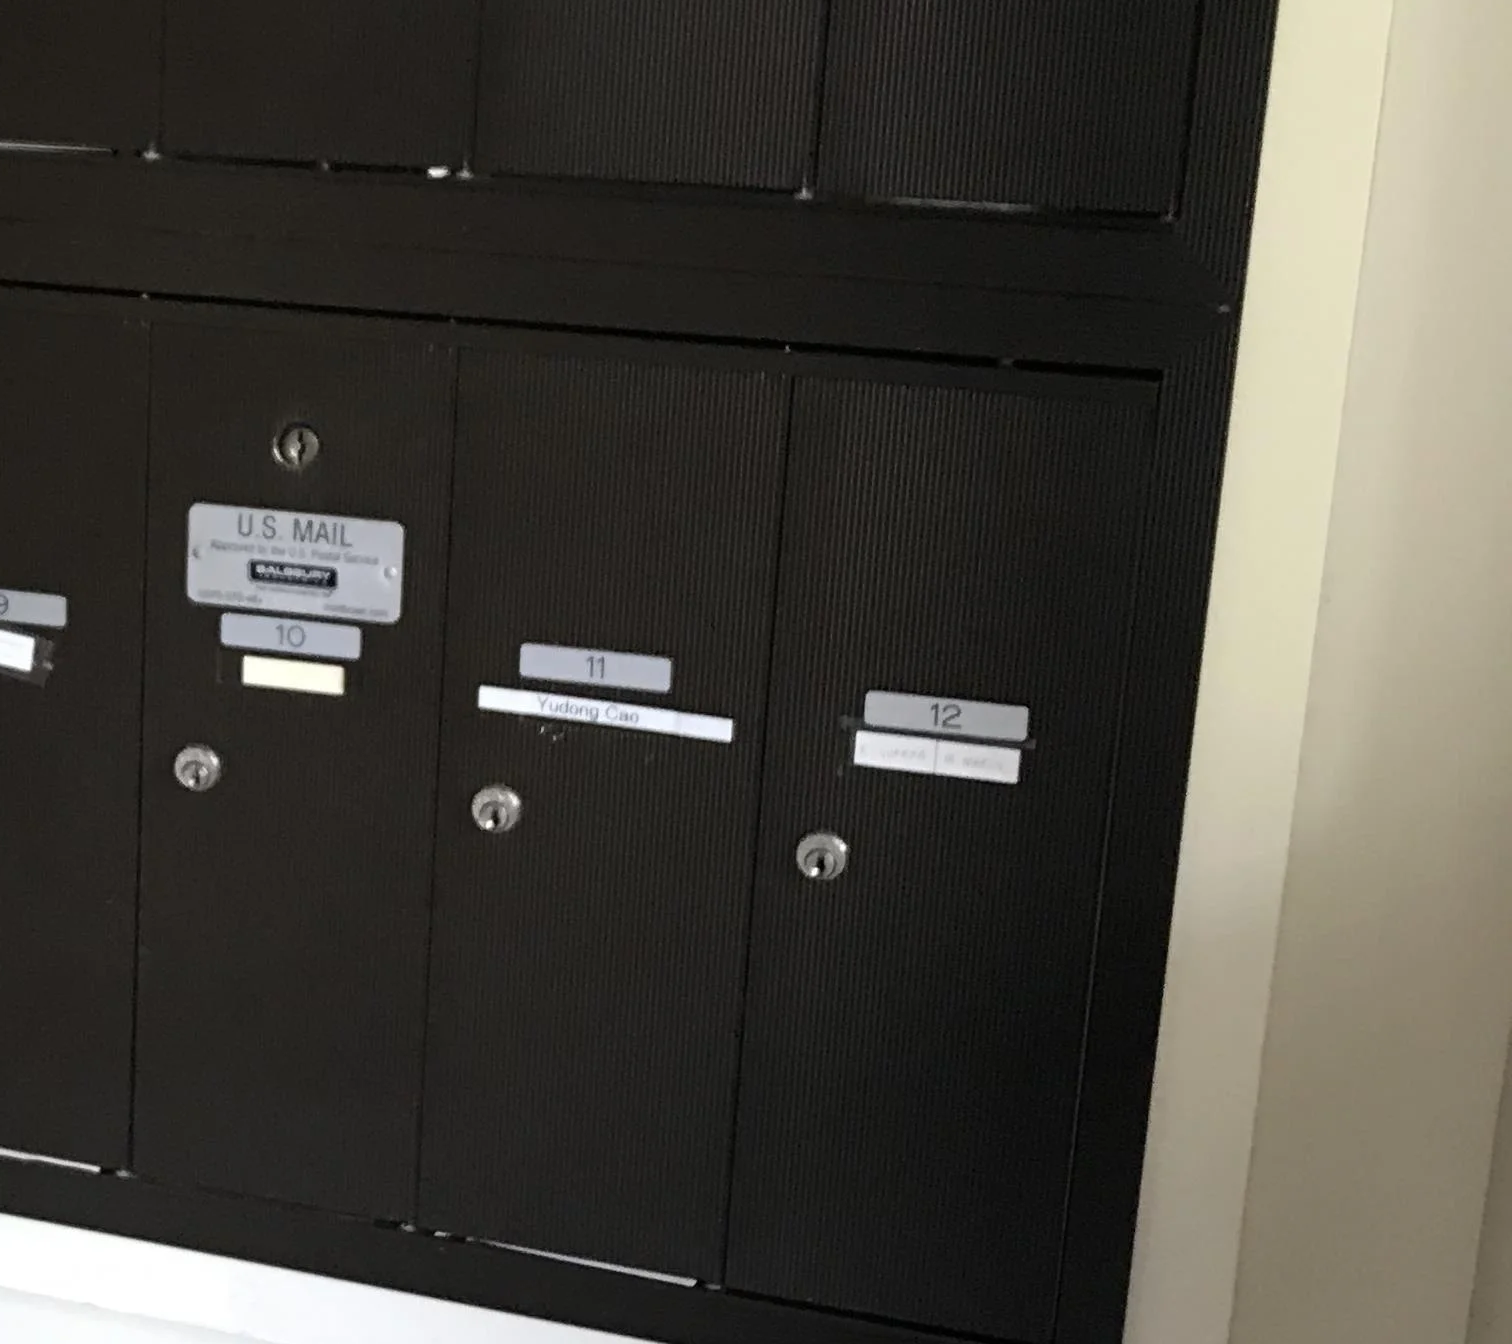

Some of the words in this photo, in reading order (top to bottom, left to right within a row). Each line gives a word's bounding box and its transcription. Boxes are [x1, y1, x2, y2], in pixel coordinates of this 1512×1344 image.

[238, 513, 284, 541] U.S.
[293, 518, 354, 548] MAIL
[275, 623, 307, 648] 10
[586, 655, 606, 679] 11
[537, 695, 600, 723] Yudong
[605, 704, 640, 725] Cao
[930, 703, 962, 730] 12
